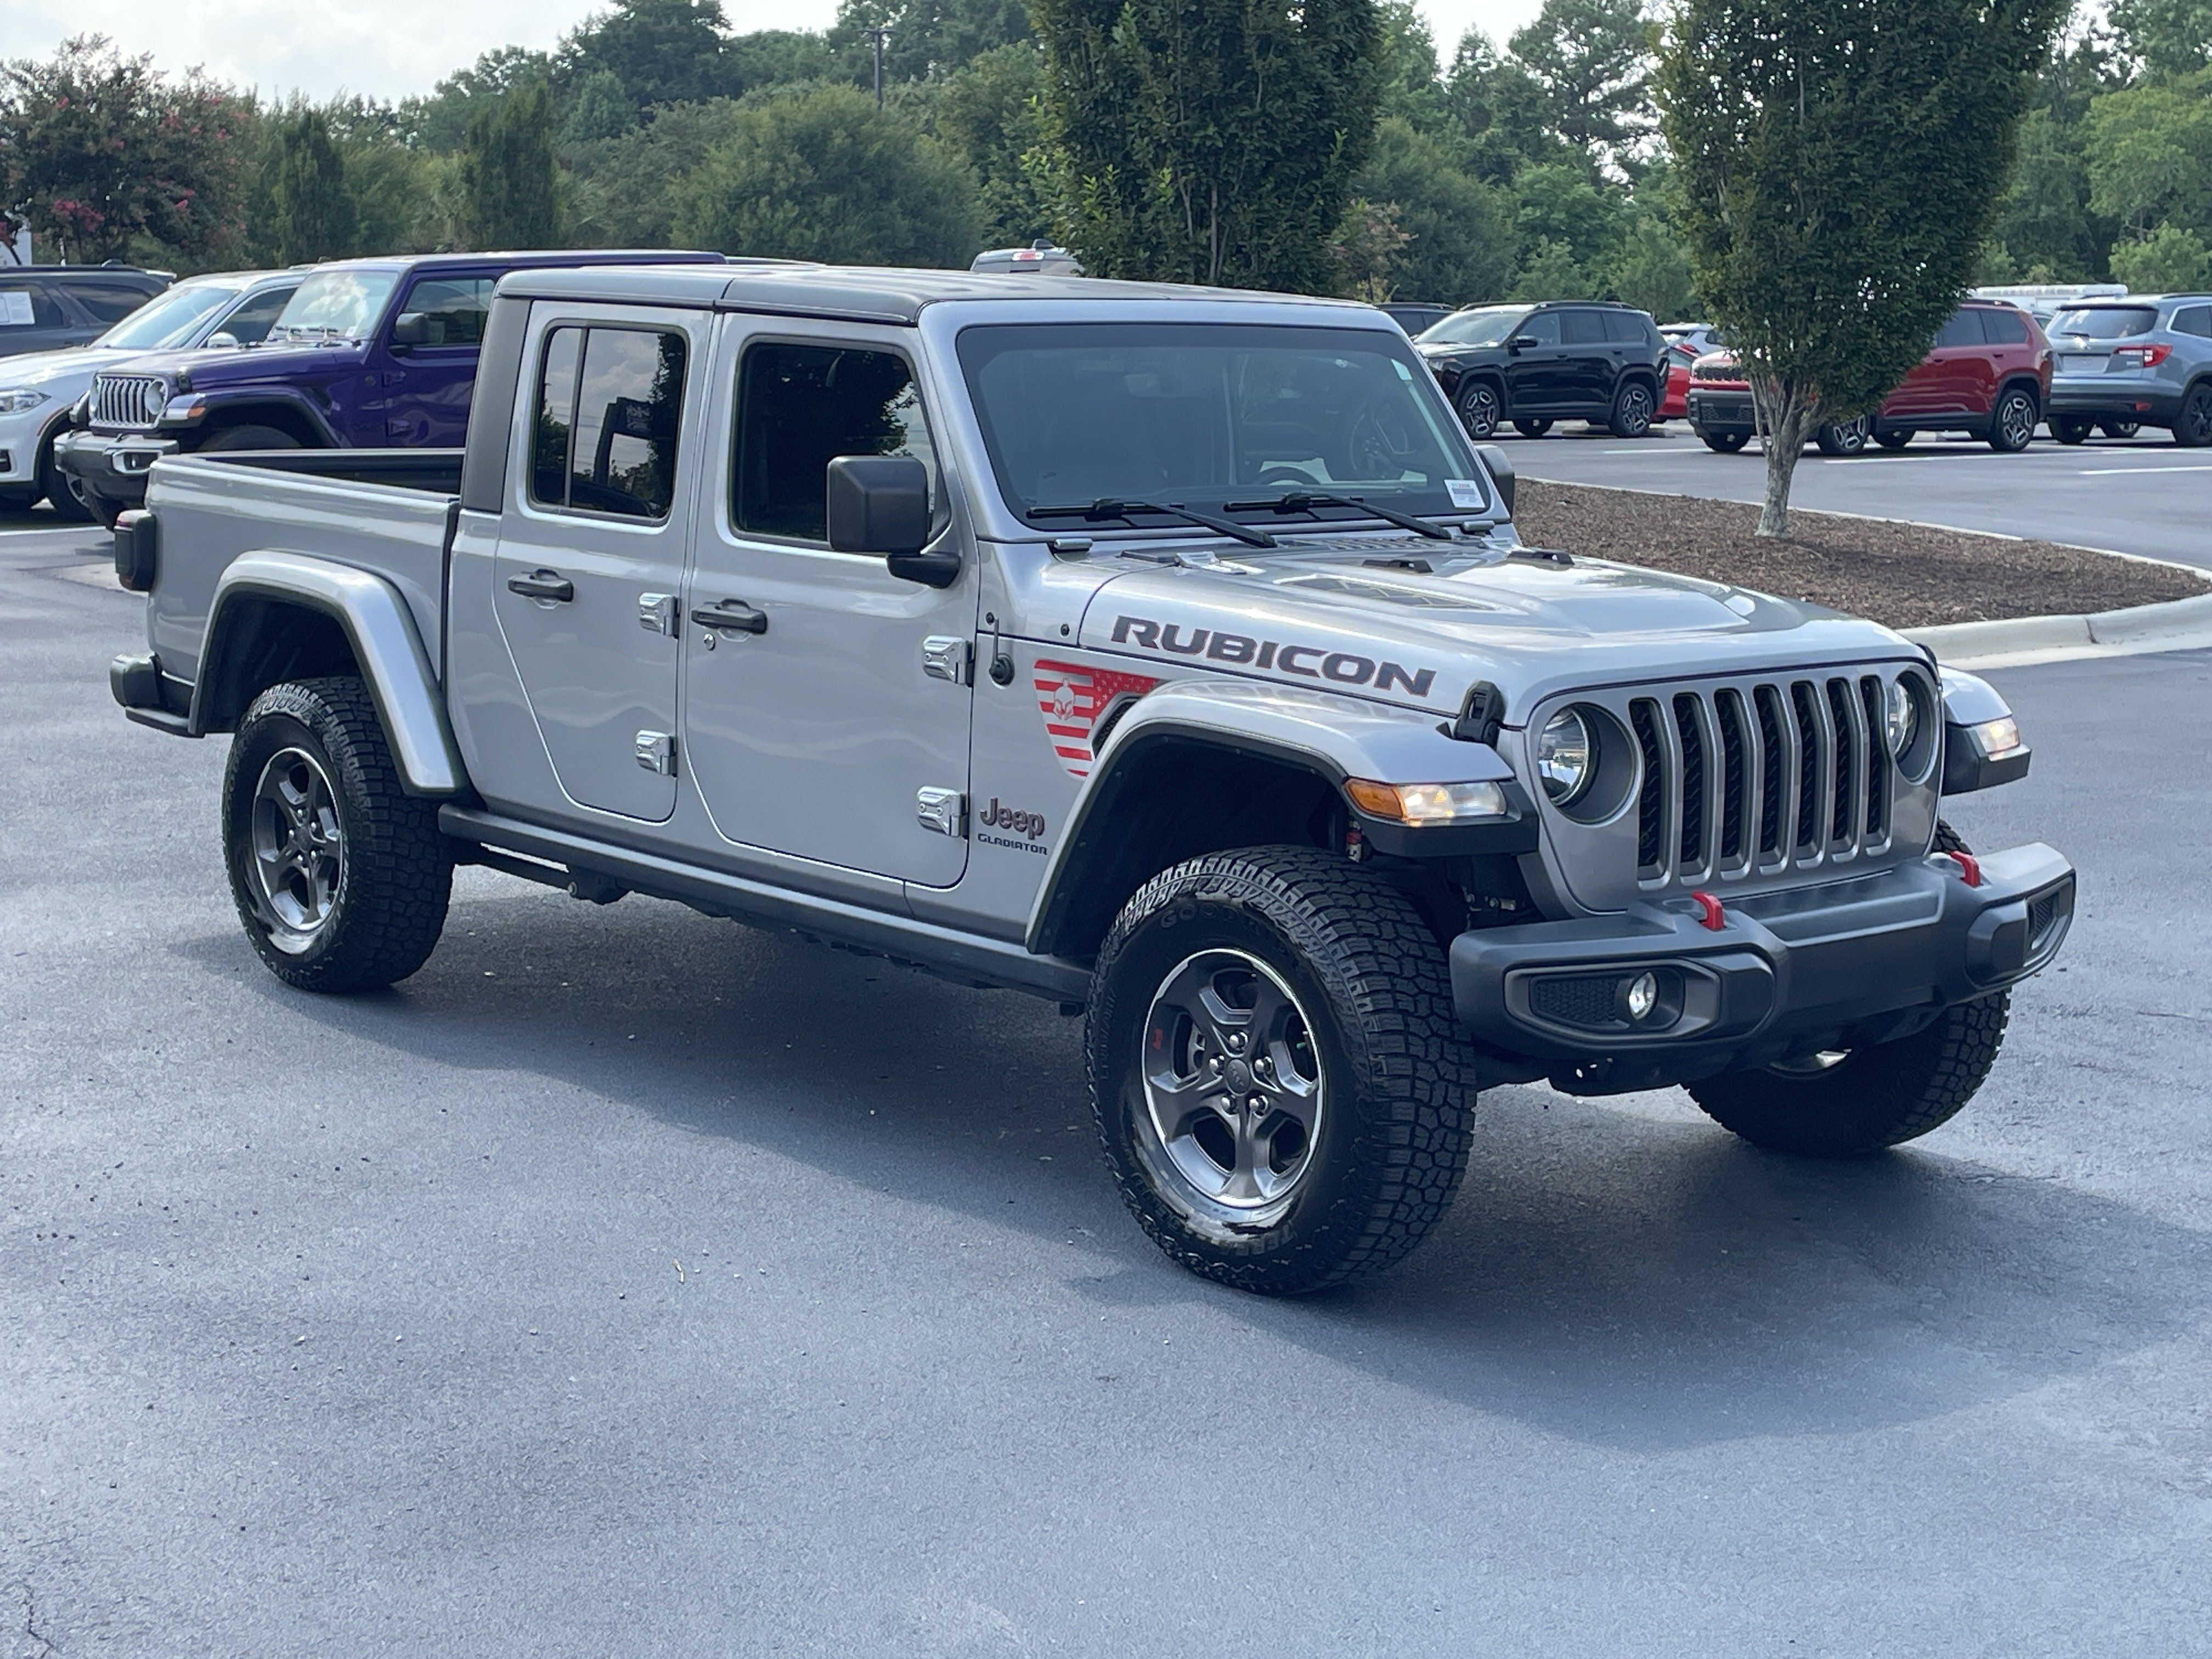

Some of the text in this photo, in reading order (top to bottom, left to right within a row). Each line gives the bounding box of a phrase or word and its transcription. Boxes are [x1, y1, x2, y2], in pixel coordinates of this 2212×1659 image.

[1110, 614, 1437, 697] RUBICON
[980, 797, 1045, 840] Jeep
[978, 833, 1048, 855] GLADIATOR
